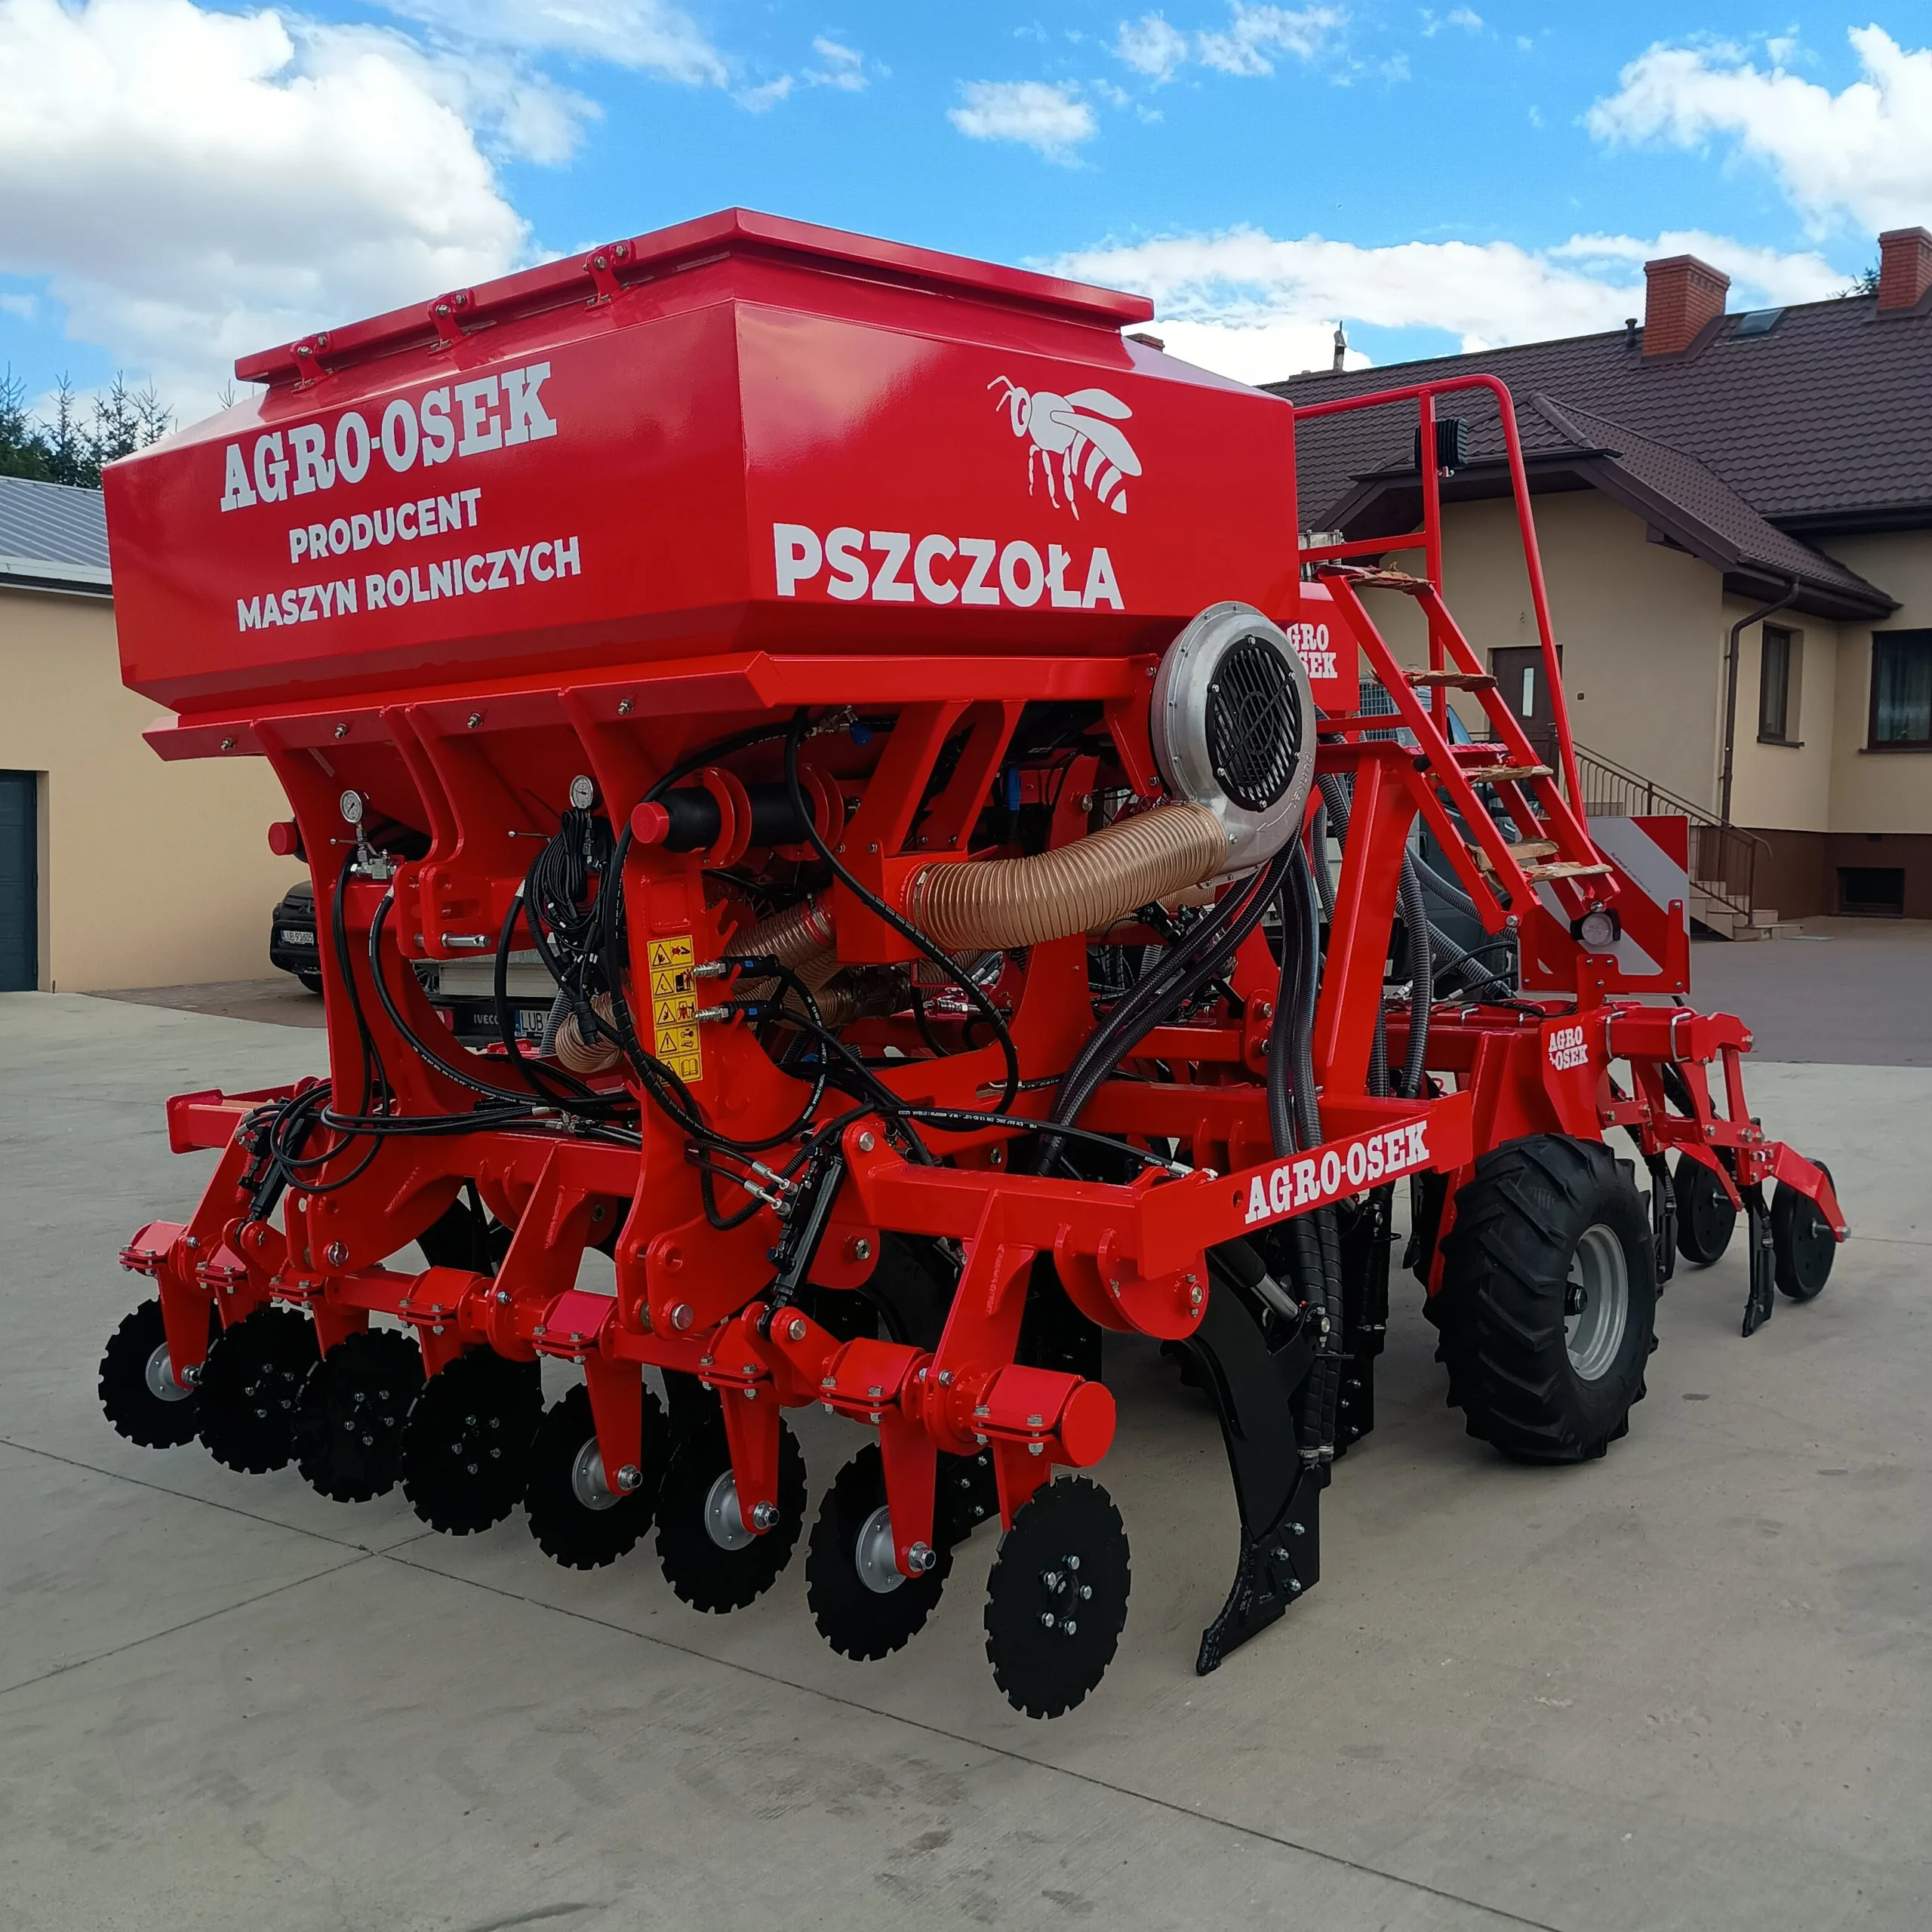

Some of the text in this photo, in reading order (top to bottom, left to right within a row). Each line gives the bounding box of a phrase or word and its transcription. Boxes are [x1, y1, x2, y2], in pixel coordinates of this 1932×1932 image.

[220, 361, 558, 513] AGRO-OSEK
[289, 488, 482, 565] PRODUCENT
[236, 536, 582, 632] MASZYN ROLNICZYCH
[773, 522, 1126, 611] PSZCZOŁA
[1286, 623, 1329, 651] GRO
[1297, 651, 1338, 678] SEK
[521, 1011, 543, 1032] LUB
[1548, 1025, 1583, 1053] AGRO
[1555, 1044, 1589, 1071] OSEK
[1244, 1120, 1430, 1225] AGRO-OSEK
